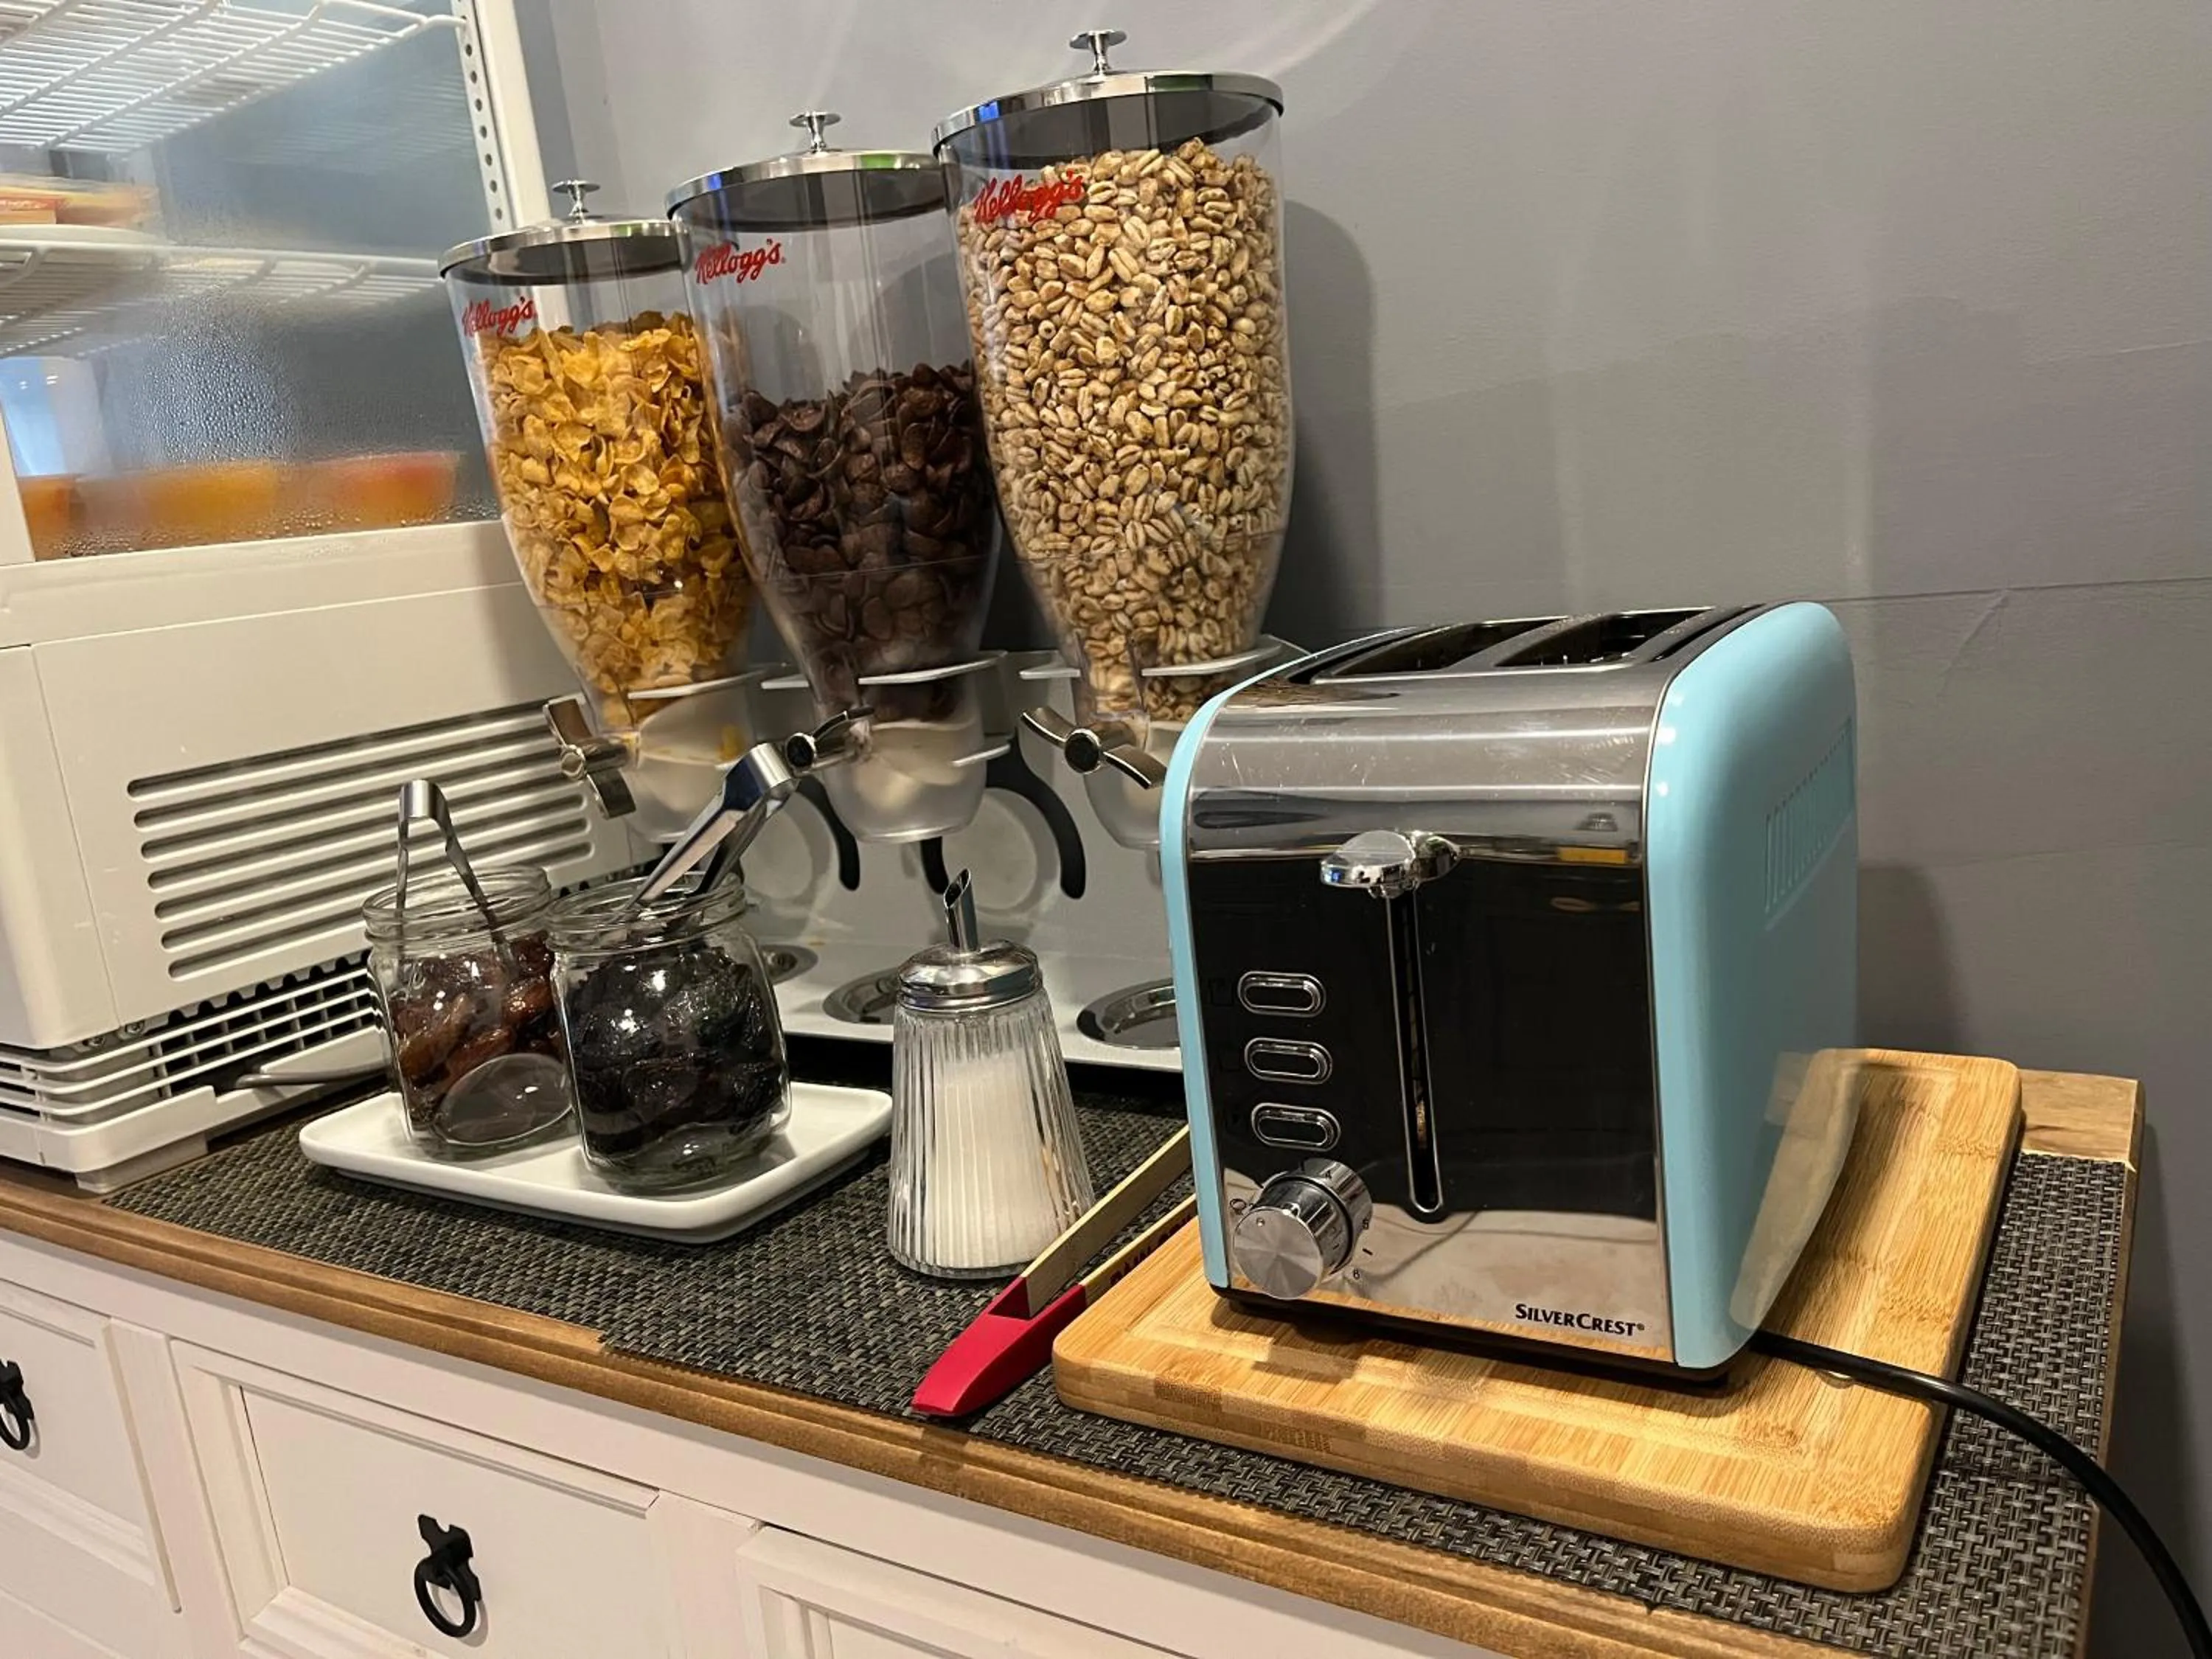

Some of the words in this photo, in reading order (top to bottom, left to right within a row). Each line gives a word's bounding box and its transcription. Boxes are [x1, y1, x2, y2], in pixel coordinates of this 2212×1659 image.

[974, 168, 1083, 224] Kellogg's
[695, 238, 782, 285] Kellogg's
[462, 296, 534, 337] Kellogg's
